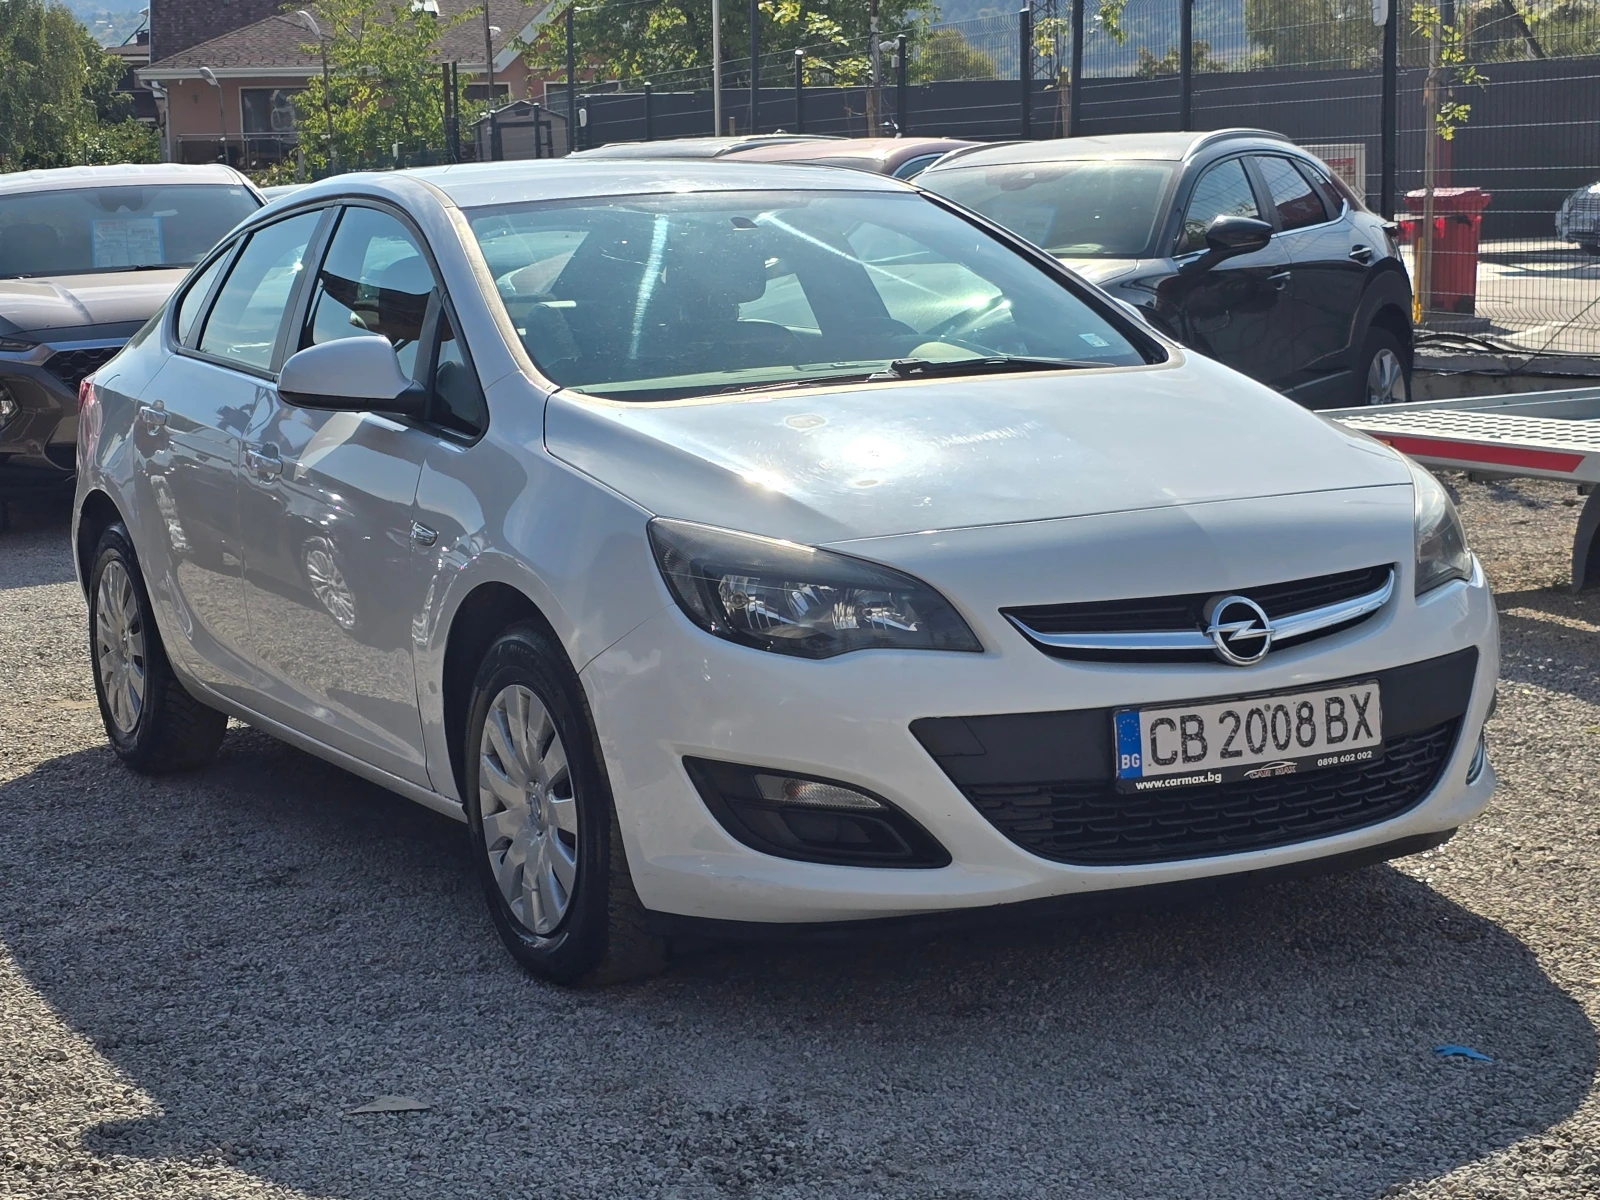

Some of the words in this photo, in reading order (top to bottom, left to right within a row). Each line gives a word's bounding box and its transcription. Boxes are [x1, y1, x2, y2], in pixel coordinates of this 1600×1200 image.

[1150, 714, 1208, 767] CB
[1218, 700, 1316, 760] 2008
[1324, 692, 1374, 745] BX
[1121, 753, 1140, 769] BG
[1317, 756, 1338, 767] 0898
[1340, 753, 1355, 763] 602
[1356, 750, 1373, 760] 002
[1135, 771, 1222, 790] www.carmax.bg
[1249, 769, 1271, 779] CAR
[1275, 765, 1296, 776] MAX
